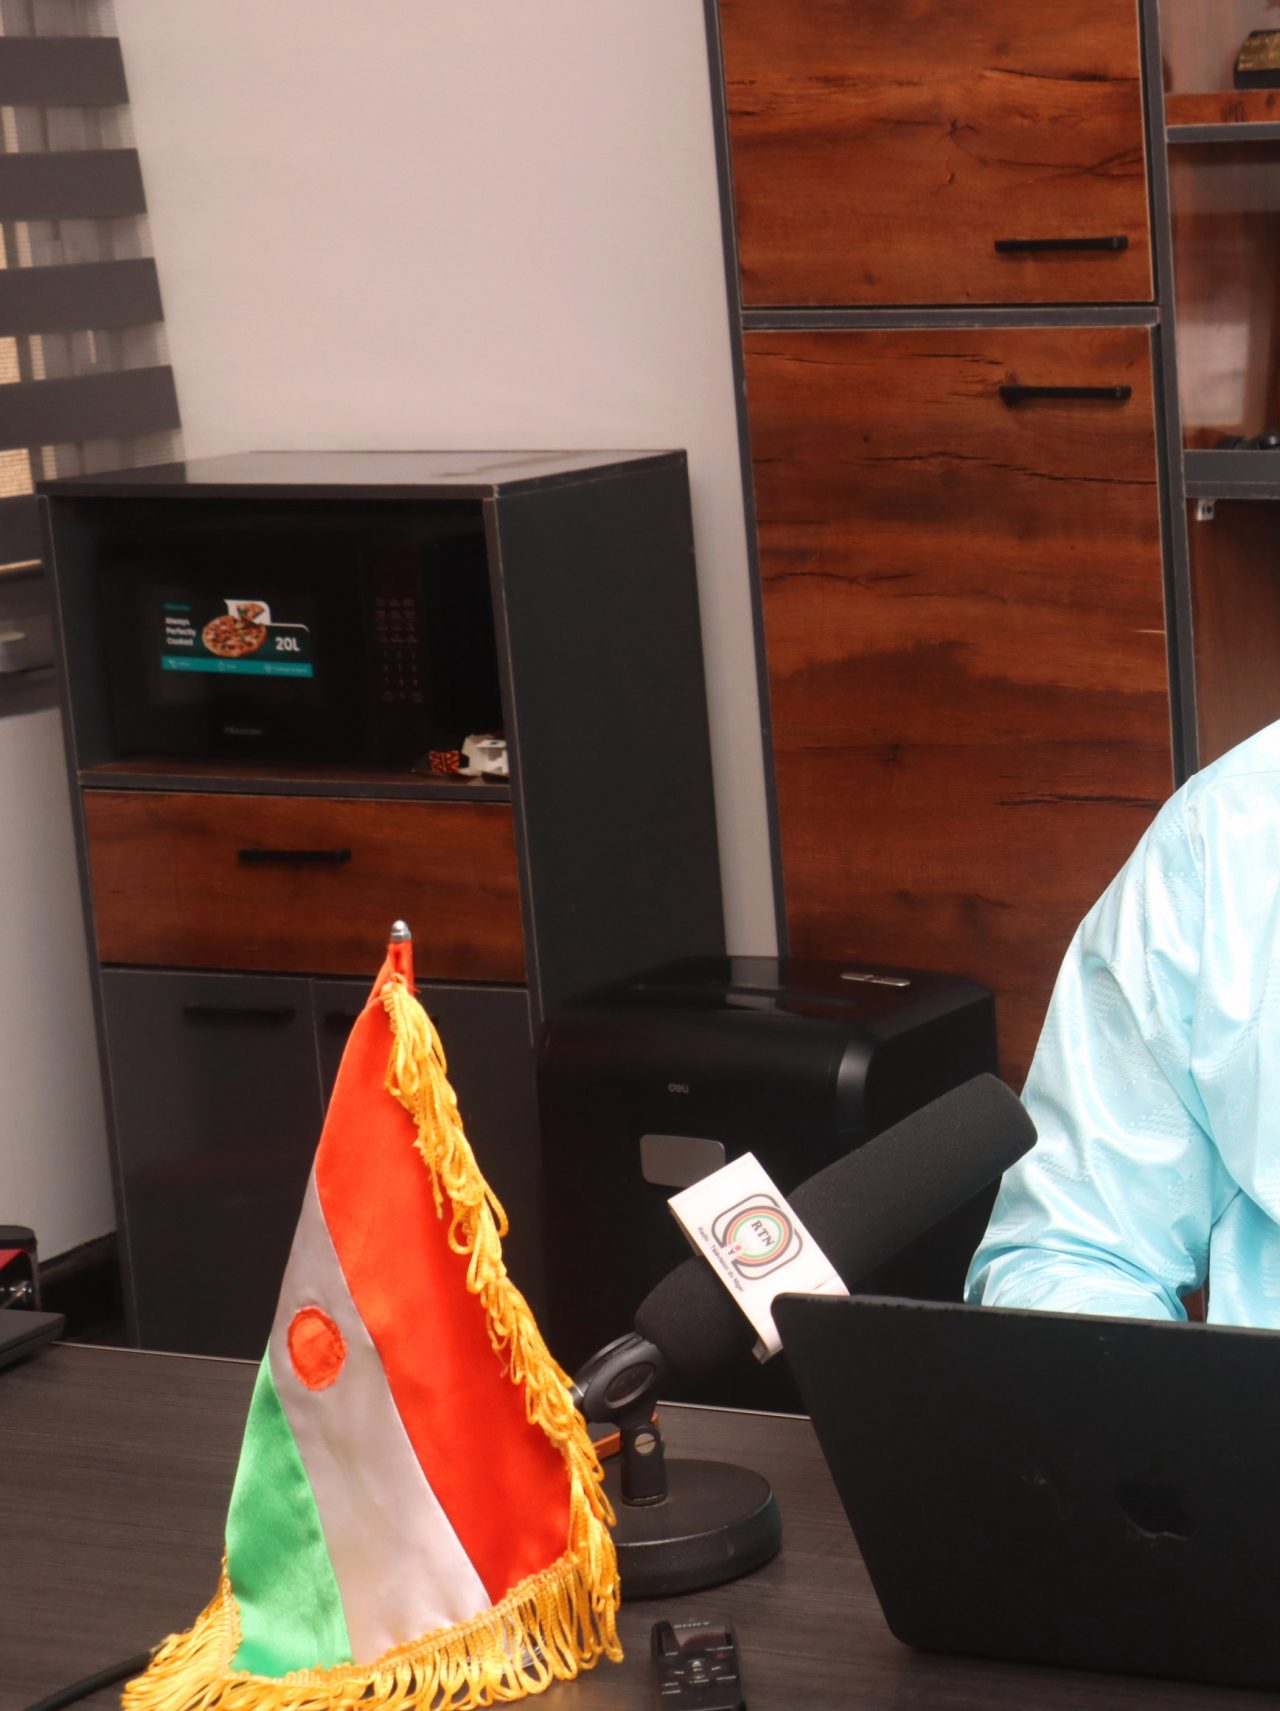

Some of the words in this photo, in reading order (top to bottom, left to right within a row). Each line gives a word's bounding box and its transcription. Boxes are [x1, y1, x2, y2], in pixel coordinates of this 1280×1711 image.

[165, 617, 190, 627] Always
[275, 637, 301, 652] 20L
[667, 1081, 689, 1094] deli
[750, 1219, 775, 1248] RTN
